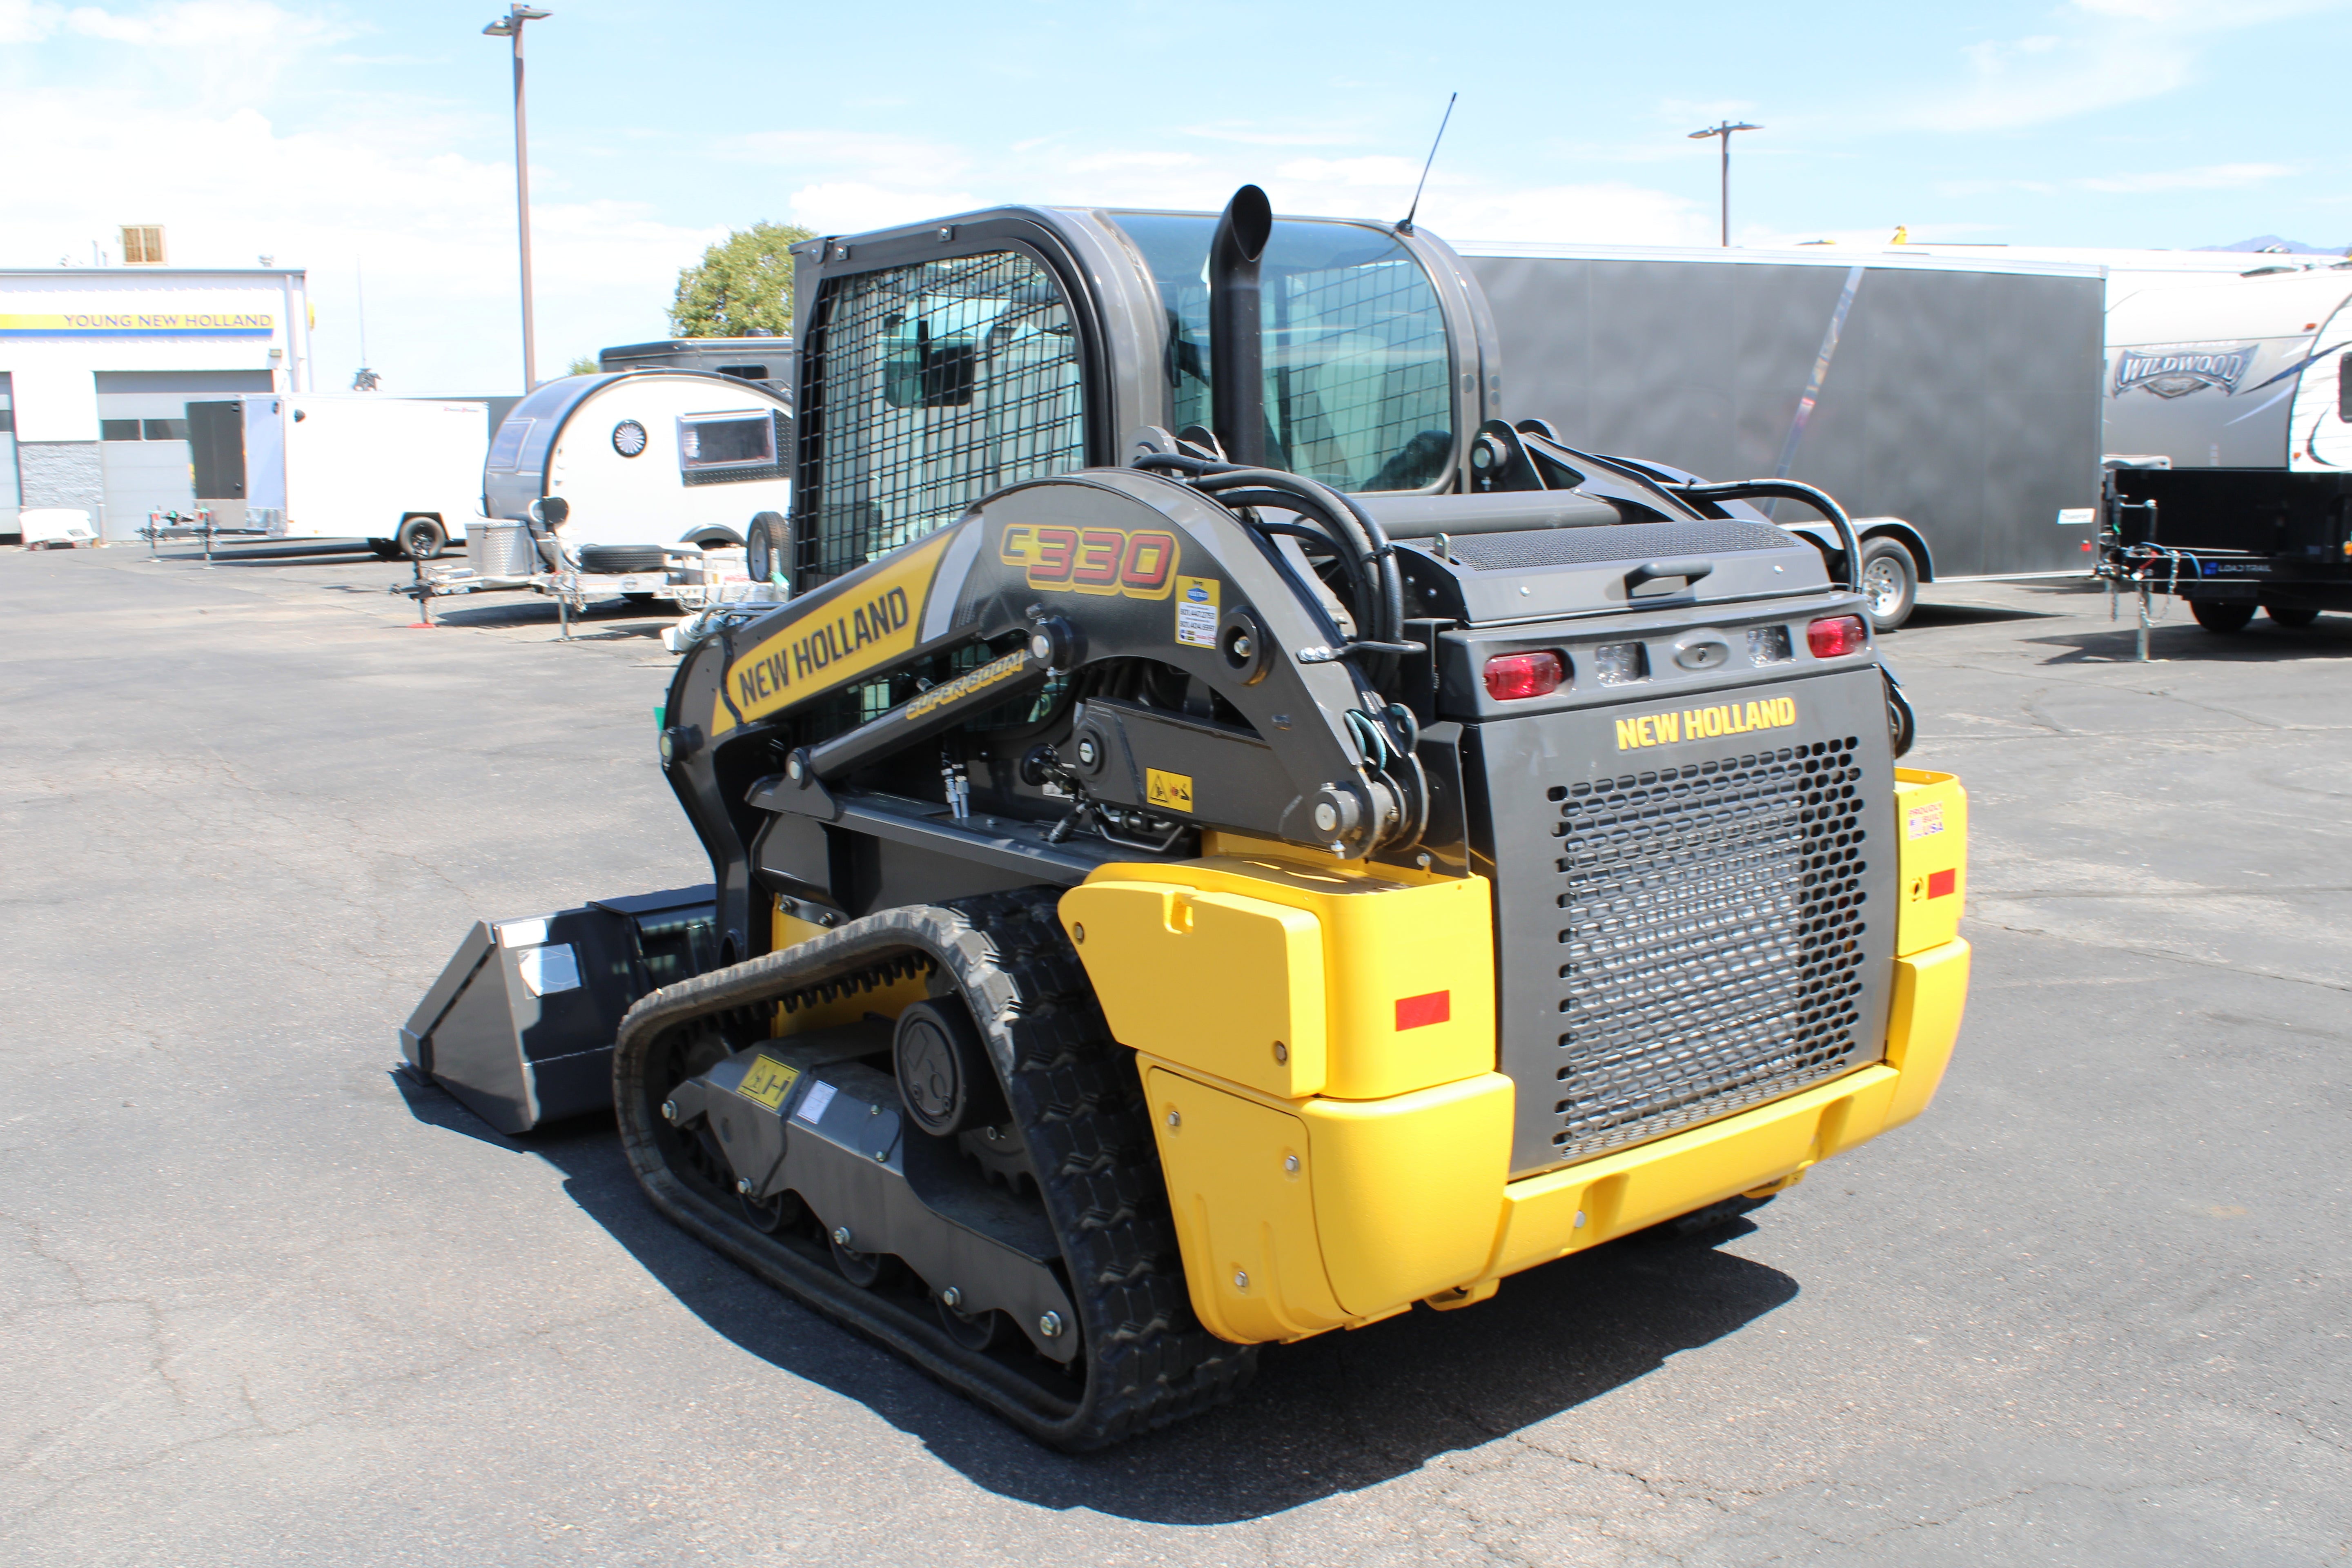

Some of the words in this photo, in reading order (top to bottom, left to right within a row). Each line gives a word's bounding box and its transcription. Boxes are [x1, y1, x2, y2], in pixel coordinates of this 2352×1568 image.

[63, 314, 132, 327] YOUNG
[138, 314, 179, 327] NEW
[186, 314, 272, 327] HOLLAND
[2122, 355, 2242, 383] WILDWOOD
[1001, 527, 1178, 593] C330
[738, 648, 789, 707] NEW
[793, 586, 909, 679] HOLLAND
[1615, 712, 1679, 750] NEW
[1683, 697, 1796, 740] HOLLAND
